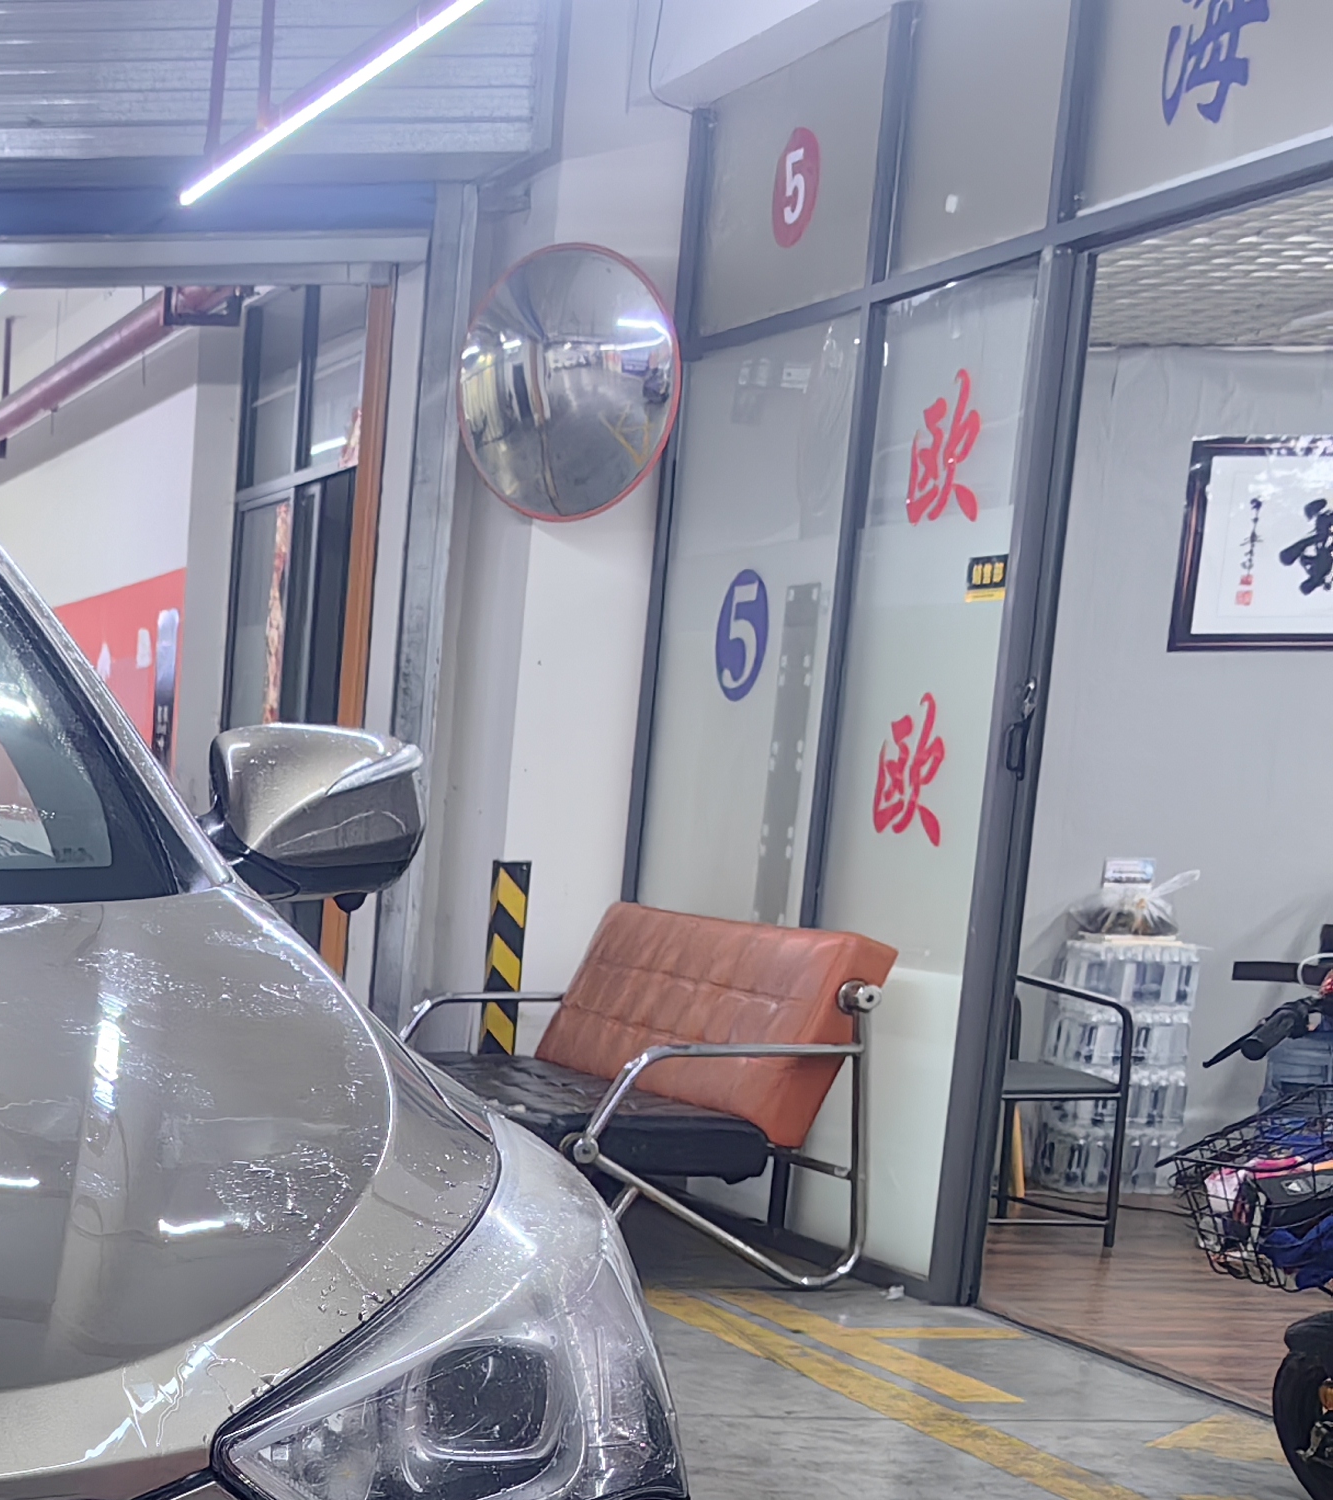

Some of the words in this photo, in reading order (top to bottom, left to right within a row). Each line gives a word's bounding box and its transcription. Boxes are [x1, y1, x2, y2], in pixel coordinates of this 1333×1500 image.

[784, 146, 805, 225] 5
[906, 368, 981, 525] 欧
[721, 580, 759, 689] 5
[873, 692, 946, 848] 欧
